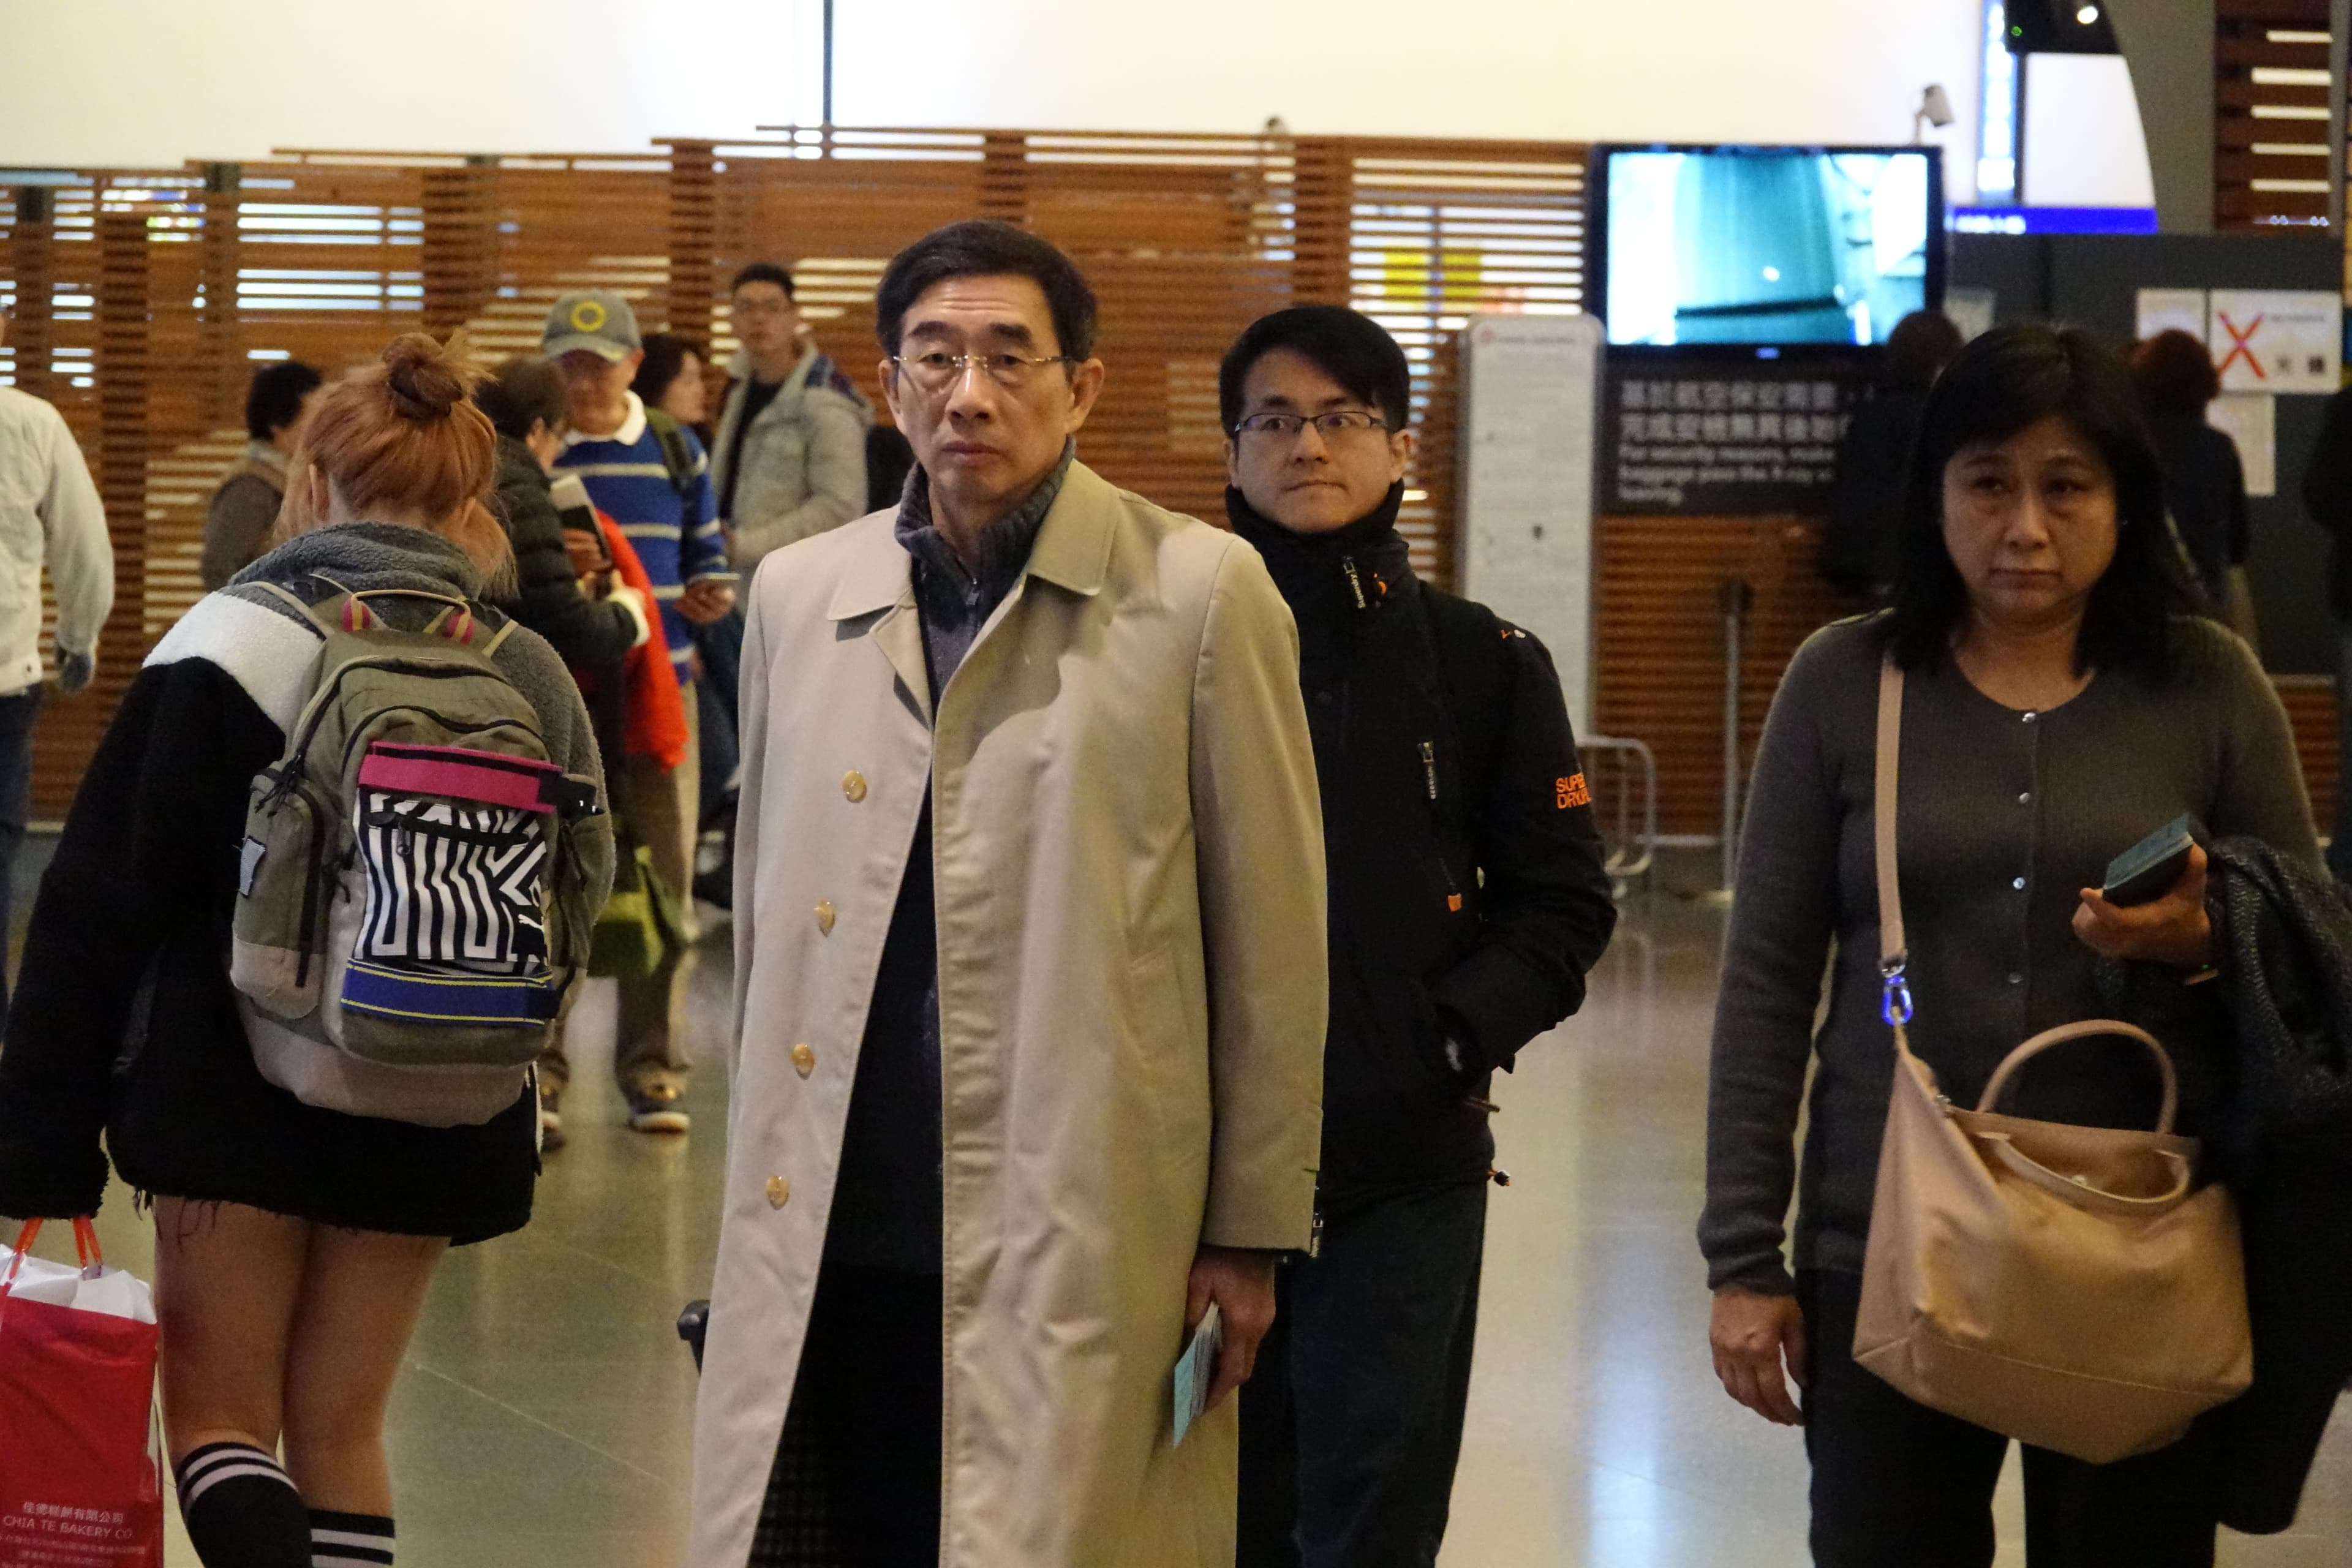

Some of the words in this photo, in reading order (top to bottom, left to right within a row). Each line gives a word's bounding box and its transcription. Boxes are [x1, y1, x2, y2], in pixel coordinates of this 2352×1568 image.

[2, 1515, 35, 1529] CHIA
[41, 1518, 56, 1531] TE
[59, 1522, 111, 1539] BAKERY
